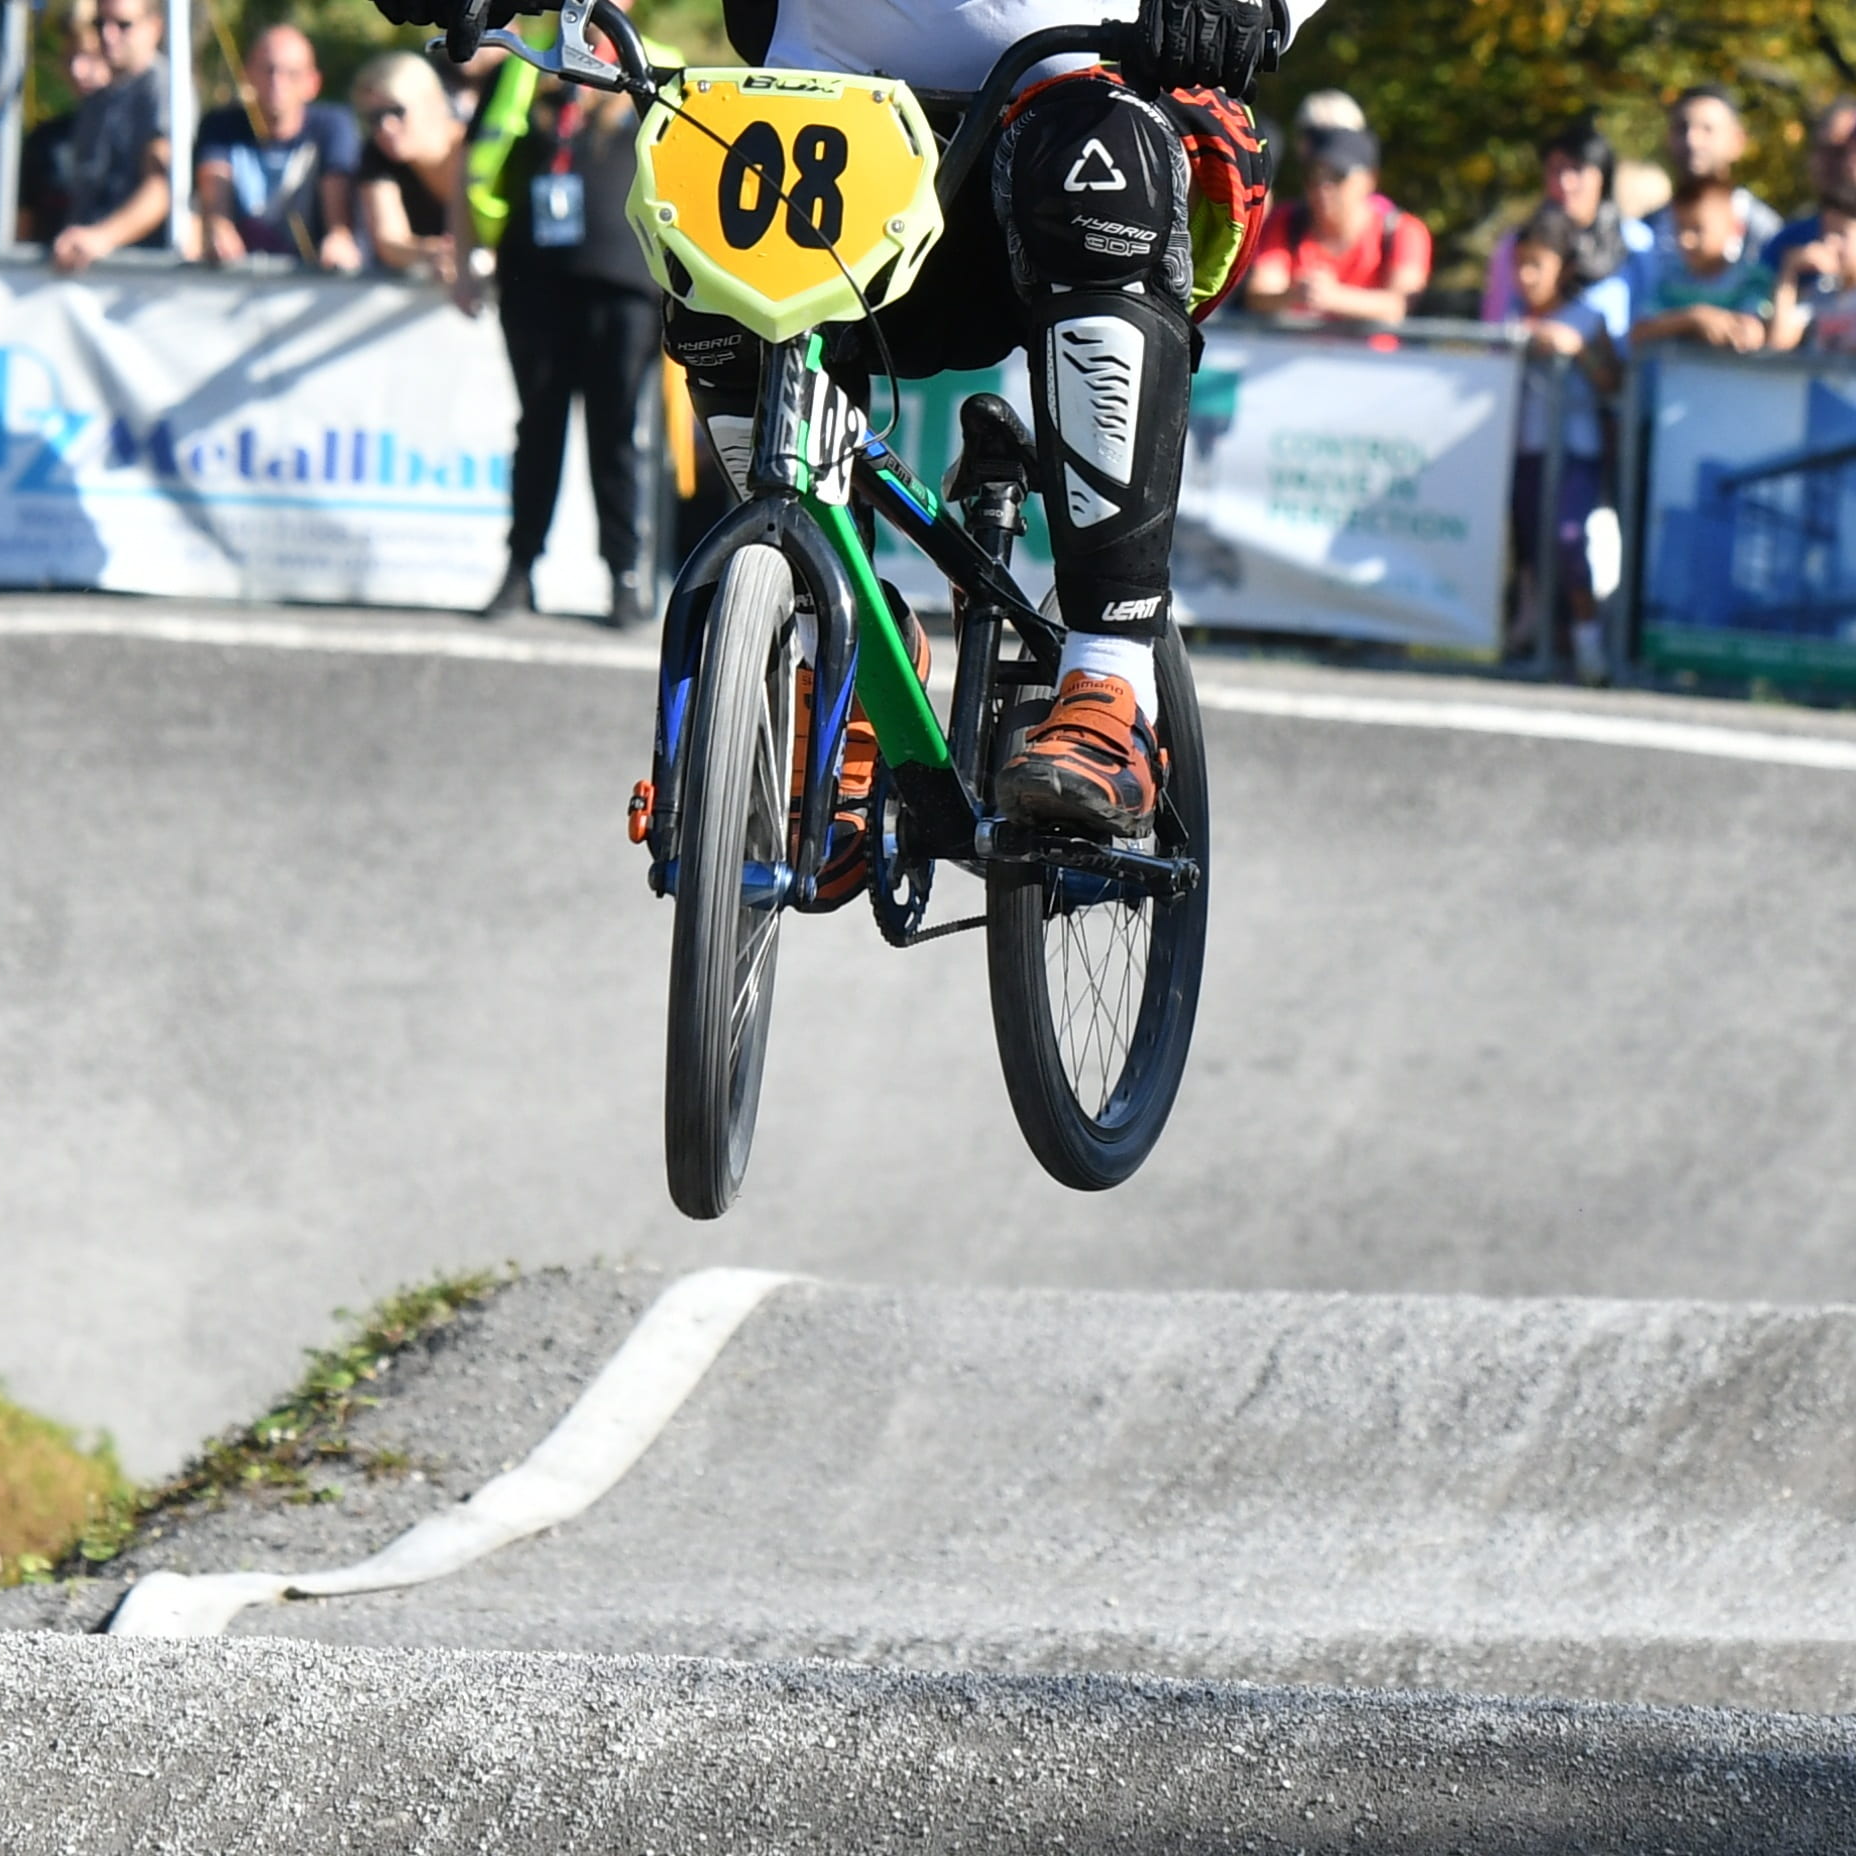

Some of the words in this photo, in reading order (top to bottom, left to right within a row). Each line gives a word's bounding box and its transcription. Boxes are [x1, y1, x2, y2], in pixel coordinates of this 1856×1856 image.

[717, 120, 848, 251] 08
[1070, 213, 1158, 242] HYBRID
[1083, 231, 1152, 257] 3DF
[676, 332, 742, 352] HYBRID
[1101, 595, 1162, 623] LEATT
